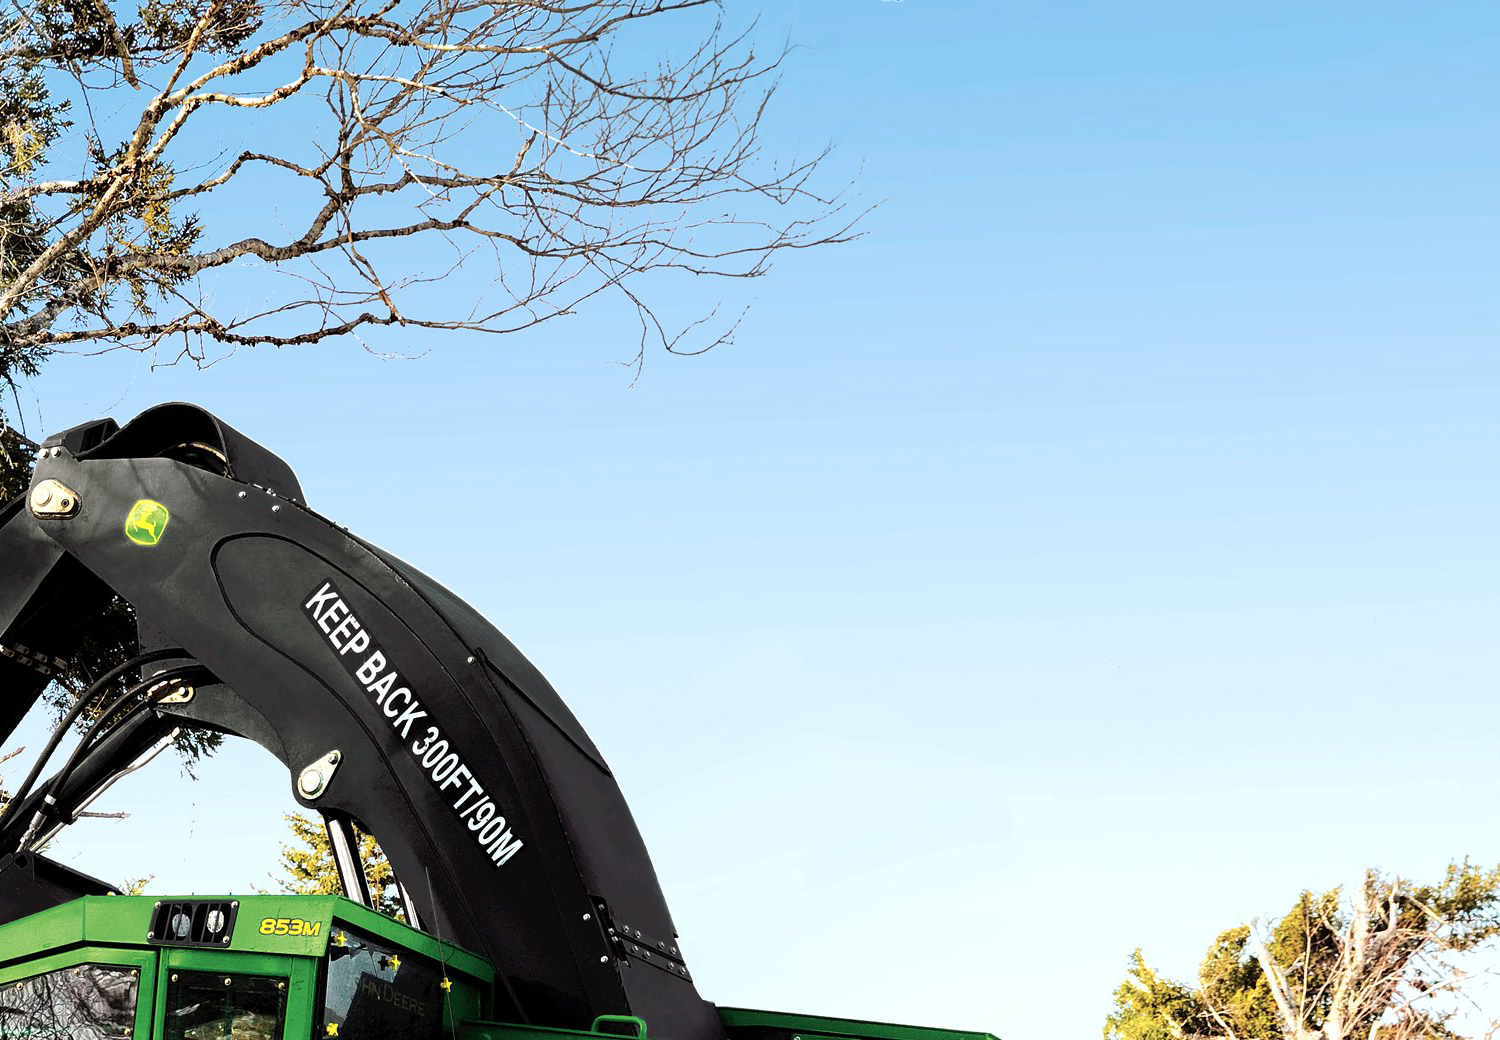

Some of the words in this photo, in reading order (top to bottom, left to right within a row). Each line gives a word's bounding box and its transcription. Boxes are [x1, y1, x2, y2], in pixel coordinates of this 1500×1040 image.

[305, 582, 370, 656] KEEP
[355, 650, 428, 739] BACK
[412, 726, 524, 867] 300FT/90M
[259, 917, 322, 936] 853M
